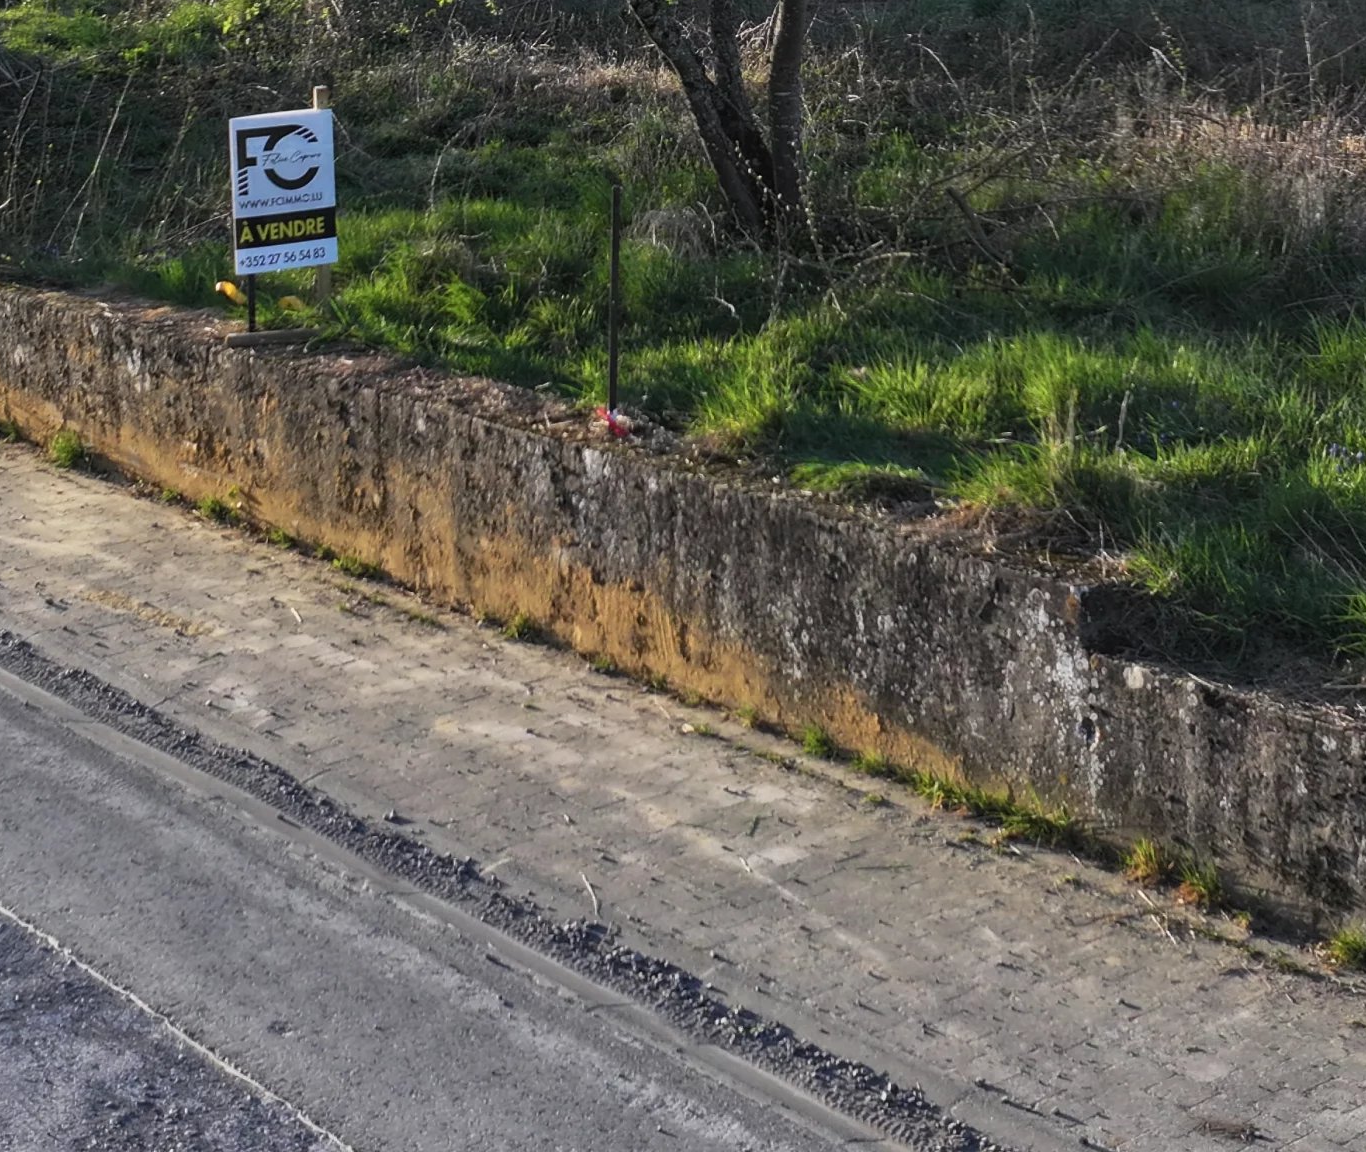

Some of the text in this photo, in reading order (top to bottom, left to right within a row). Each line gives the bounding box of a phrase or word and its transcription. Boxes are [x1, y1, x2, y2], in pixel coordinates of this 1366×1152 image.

[239, 192, 322, 209] WWW.FCIMMO.LU
[240, 217, 325, 243] À VENDRE
[240, 247, 325, 267] +352 27 56 54 83
